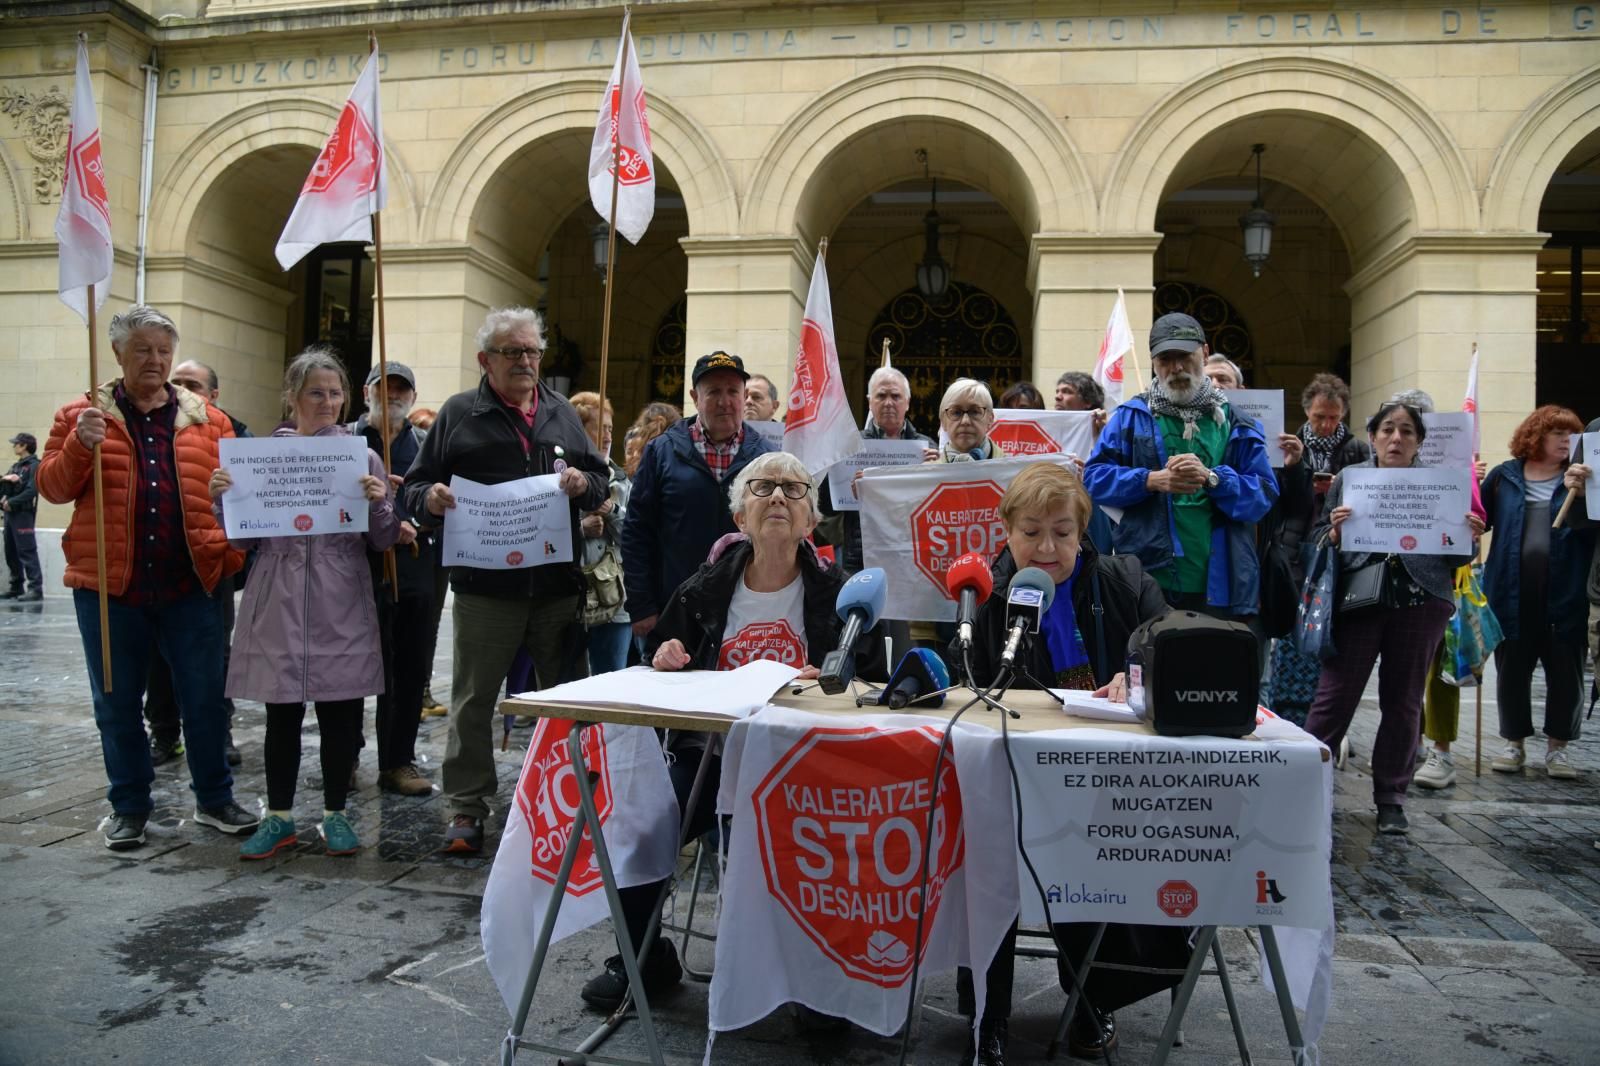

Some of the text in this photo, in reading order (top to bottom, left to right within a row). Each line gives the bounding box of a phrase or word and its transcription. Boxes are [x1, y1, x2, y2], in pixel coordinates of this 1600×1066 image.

[167, 53, 389, 89] GIPUZKOAKO
[438, 42, 537, 69] FORU
[588, 29, 798, 63] ADUNDIA
[893, 16, 1166, 48] DIPUTACION
[1226, 12, 1376, 38] FORAL
[1441, 9, 1498, 35] DE
[995, 440, 1050, 453] LERATZEAK
[230, 457, 245, 465] SIN
[285, 455, 297, 463] DE
[299, 454, 357, 463] REFERENCIA,
[253, 467, 266, 475] NO
[282, 466, 317, 474] LIMITAN
[318, 465, 336, 473] LOS
[268, 476, 323, 485] ALQUILERES
[256, 489, 336, 498] HACIENDA FORAL,
[1407, 484, 1461, 492] REFERENCIA,
[263, 499, 329, 508] RESPONSABLE
[468, 503, 549, 518] EZ DIRA ALOKAIRUAK
[926, 507, 1001, 525] KALERATZEA
[489, 516, 532, 527] MUGATZEN
[477, 529, 501, 537] FORU
[928, 520, 1008, 557] STOP
[480, 535, 537, 546] ARDURADUNA!
[1175, 690, 1239, 703] VONYX
[1036, 750, 1288, 766] ERREFERENTZIA-INDIZERIK,
[1064, 774, 1260, 788] EZ DIRA ALOKAIRUAK
[1112, 798, 1213, 811] MUGATZEN
[1087, 824, 1240, 840] FORU OGASUNA,
[792, 806, 946, 887] STOP
[1096, 848, 1232, 862] ARDURADUNA!
[1162, 892, 1193, 904] STOP
